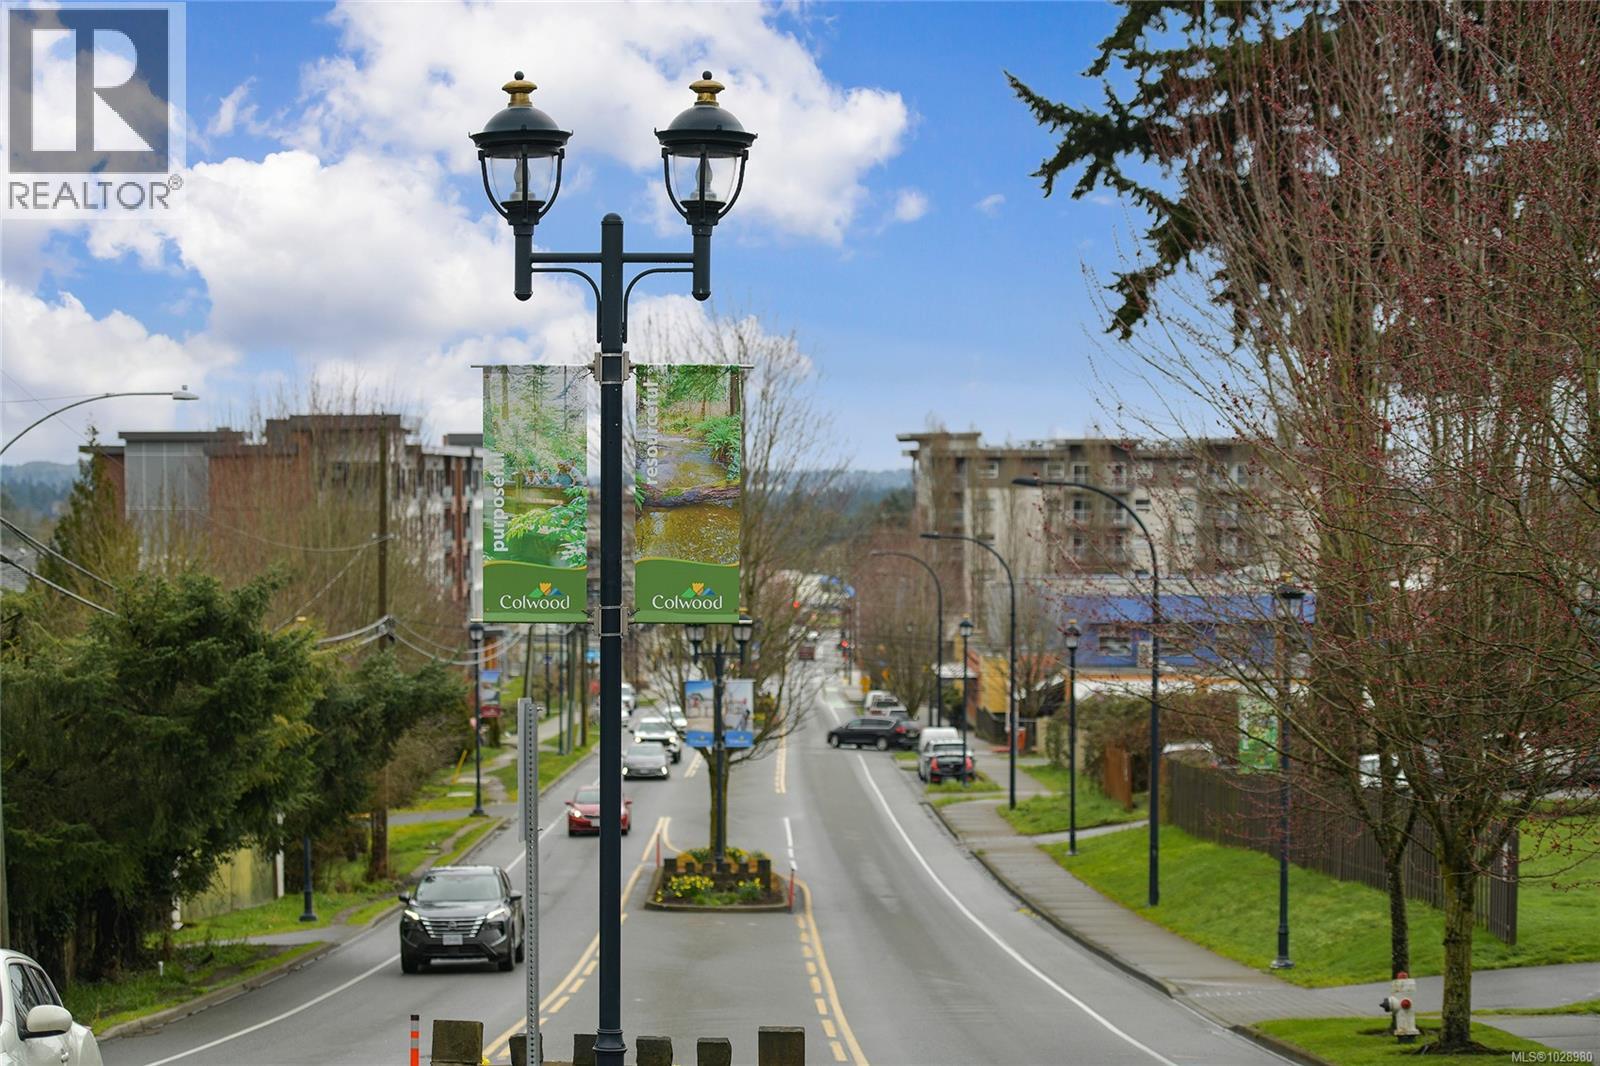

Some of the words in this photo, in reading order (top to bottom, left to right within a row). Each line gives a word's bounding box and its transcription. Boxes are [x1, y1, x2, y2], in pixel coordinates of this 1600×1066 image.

[642, 382, 658, 485] resourceful
[499, 595, 570, 610] Colwood
[652, 595, 723, 610] Colwood
